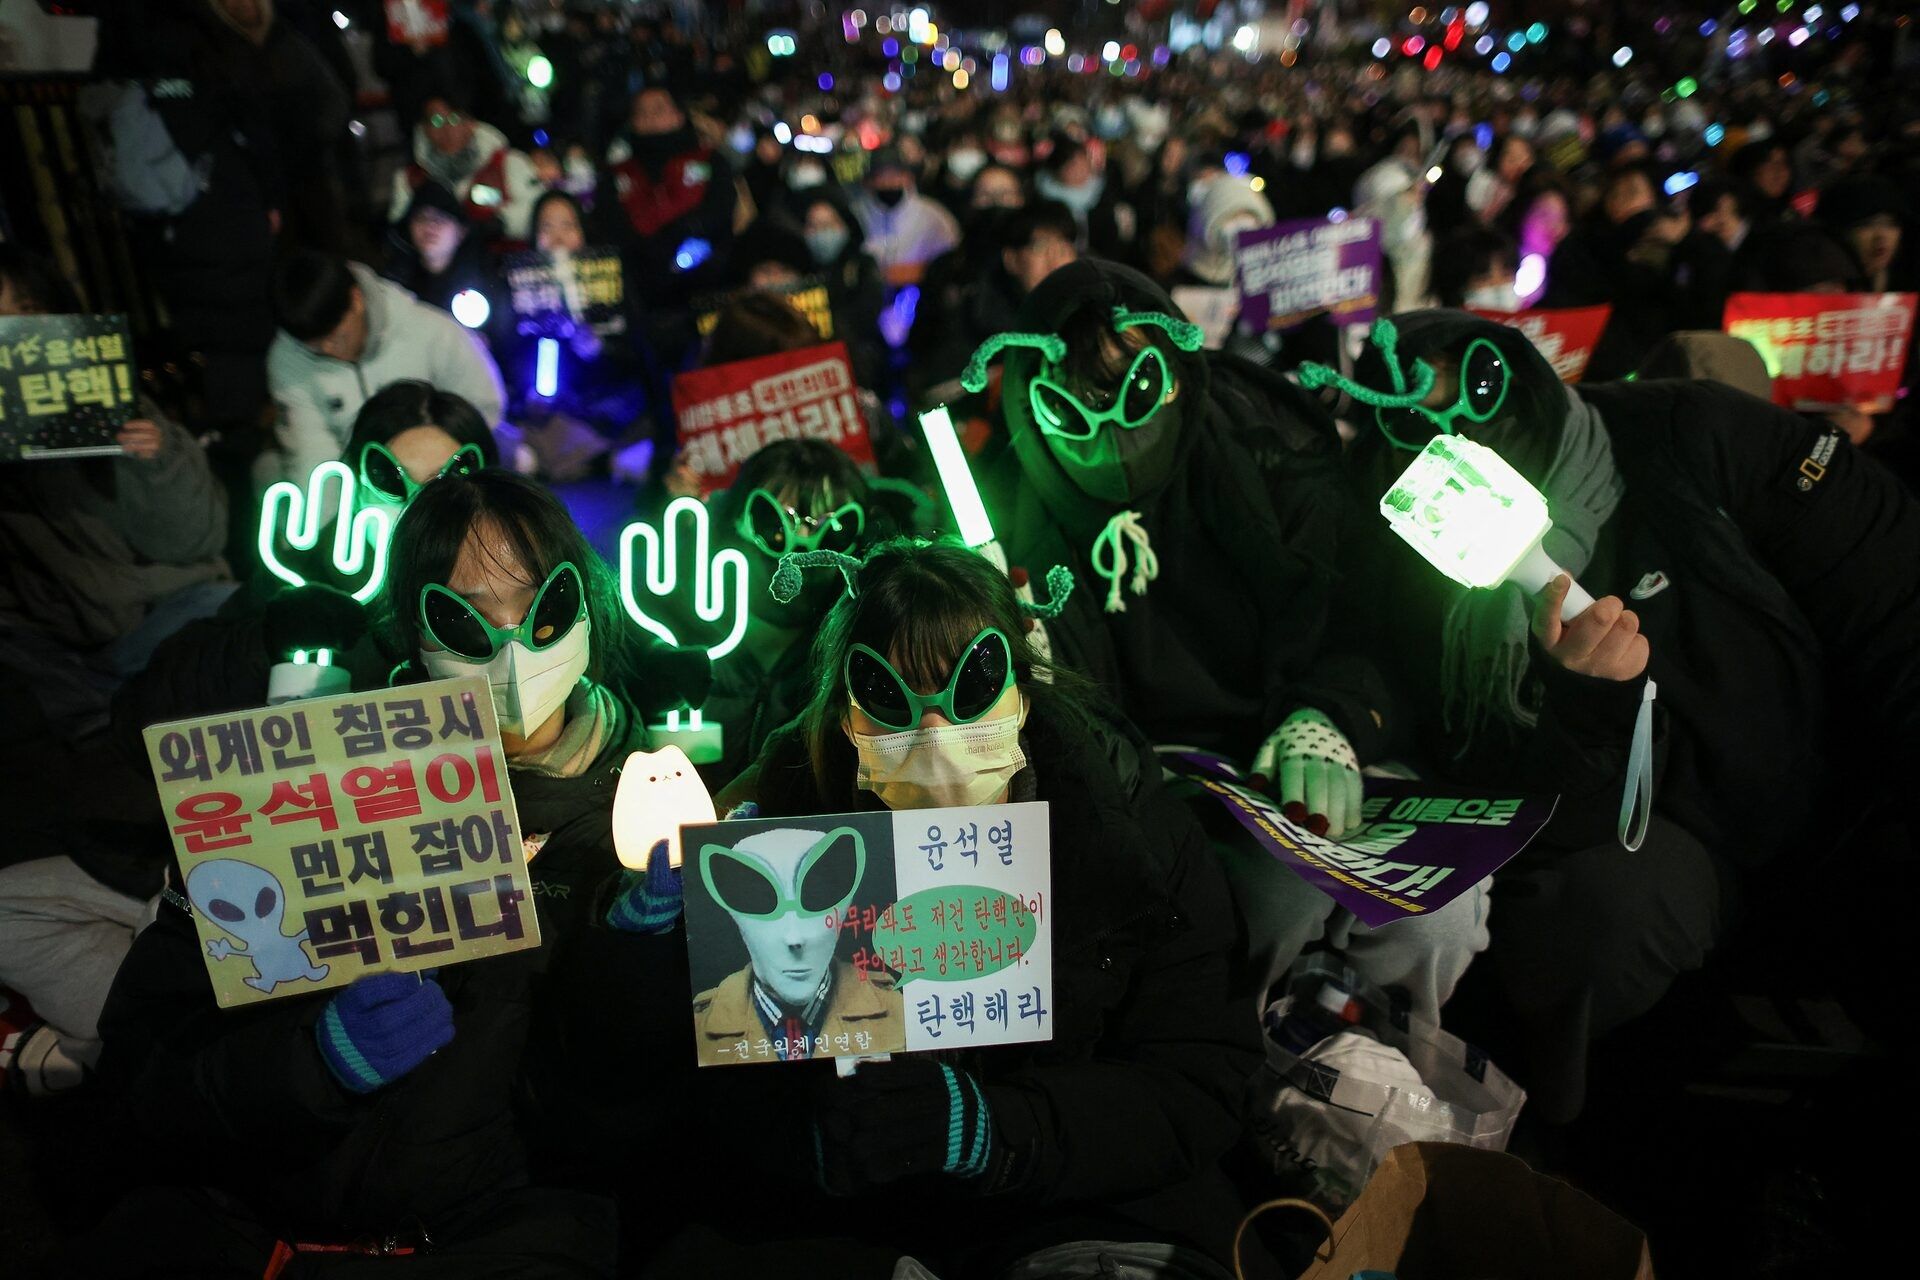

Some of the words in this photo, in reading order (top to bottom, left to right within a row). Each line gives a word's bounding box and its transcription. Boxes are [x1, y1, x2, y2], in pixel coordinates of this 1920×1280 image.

[19, 364, 133, 417] 탄핵!
[158, 711, 316, 783] 외계인
[333, 691, 486, 759] 침공시
[173, 745, 502, 854] 윤석열이
[1388, 796, 1525, 827] 이름으로
[290, 830, 396, 898] 먼저
[410, 809, 514, 877] 잡아
[918, 819, 1014, 872] 윤석열
[1294, 849, 1332, 870] OUT
[303, 874, 525, 966] 먹힌다
[931, 897, 964, 933] 저건
[974, 891, 1044, 931] 탄핵만이
[852, 945, 925, 983] 답이라고
[933, 935, 1029, 976] 생각합니다.
[916, 986, 1048, 1038] 탄핵해라
